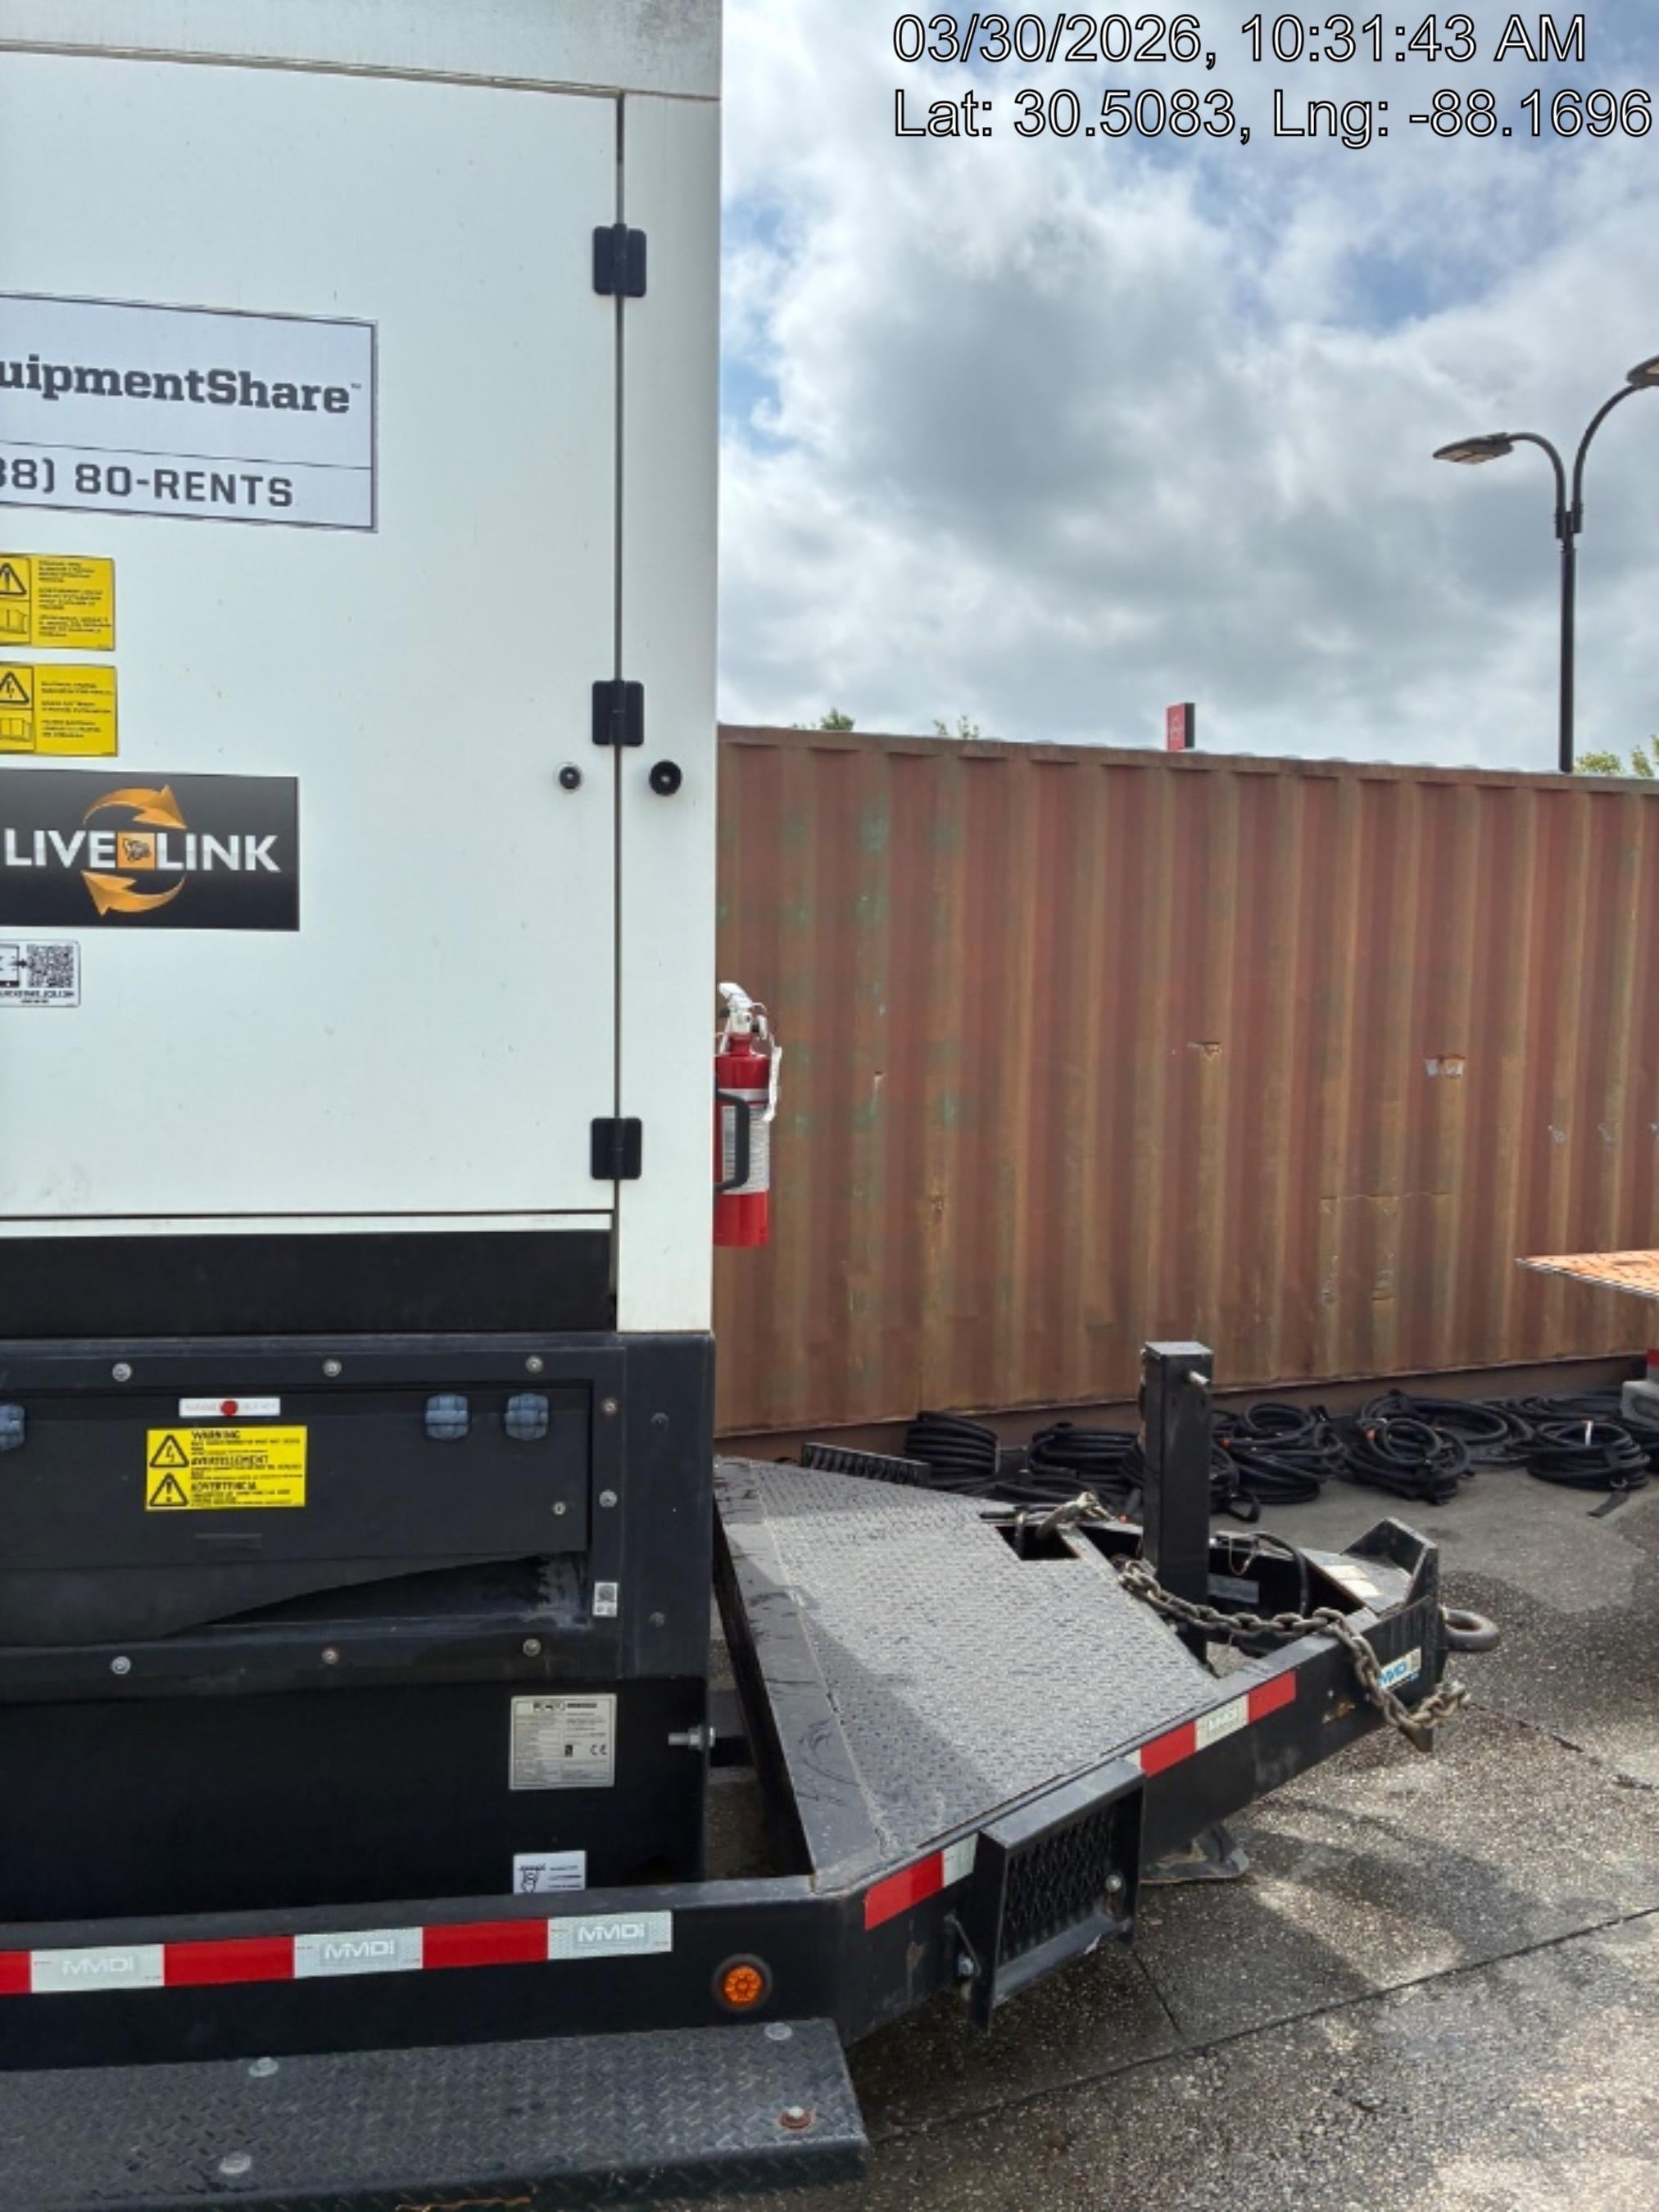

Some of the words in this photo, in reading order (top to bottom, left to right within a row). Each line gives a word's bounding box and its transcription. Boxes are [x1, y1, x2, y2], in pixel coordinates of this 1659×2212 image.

[75, 463, 293, 508] 80-RENTS
[4, 827, 116, 868] LIVE
[156, 832, 281, 873] LINK
